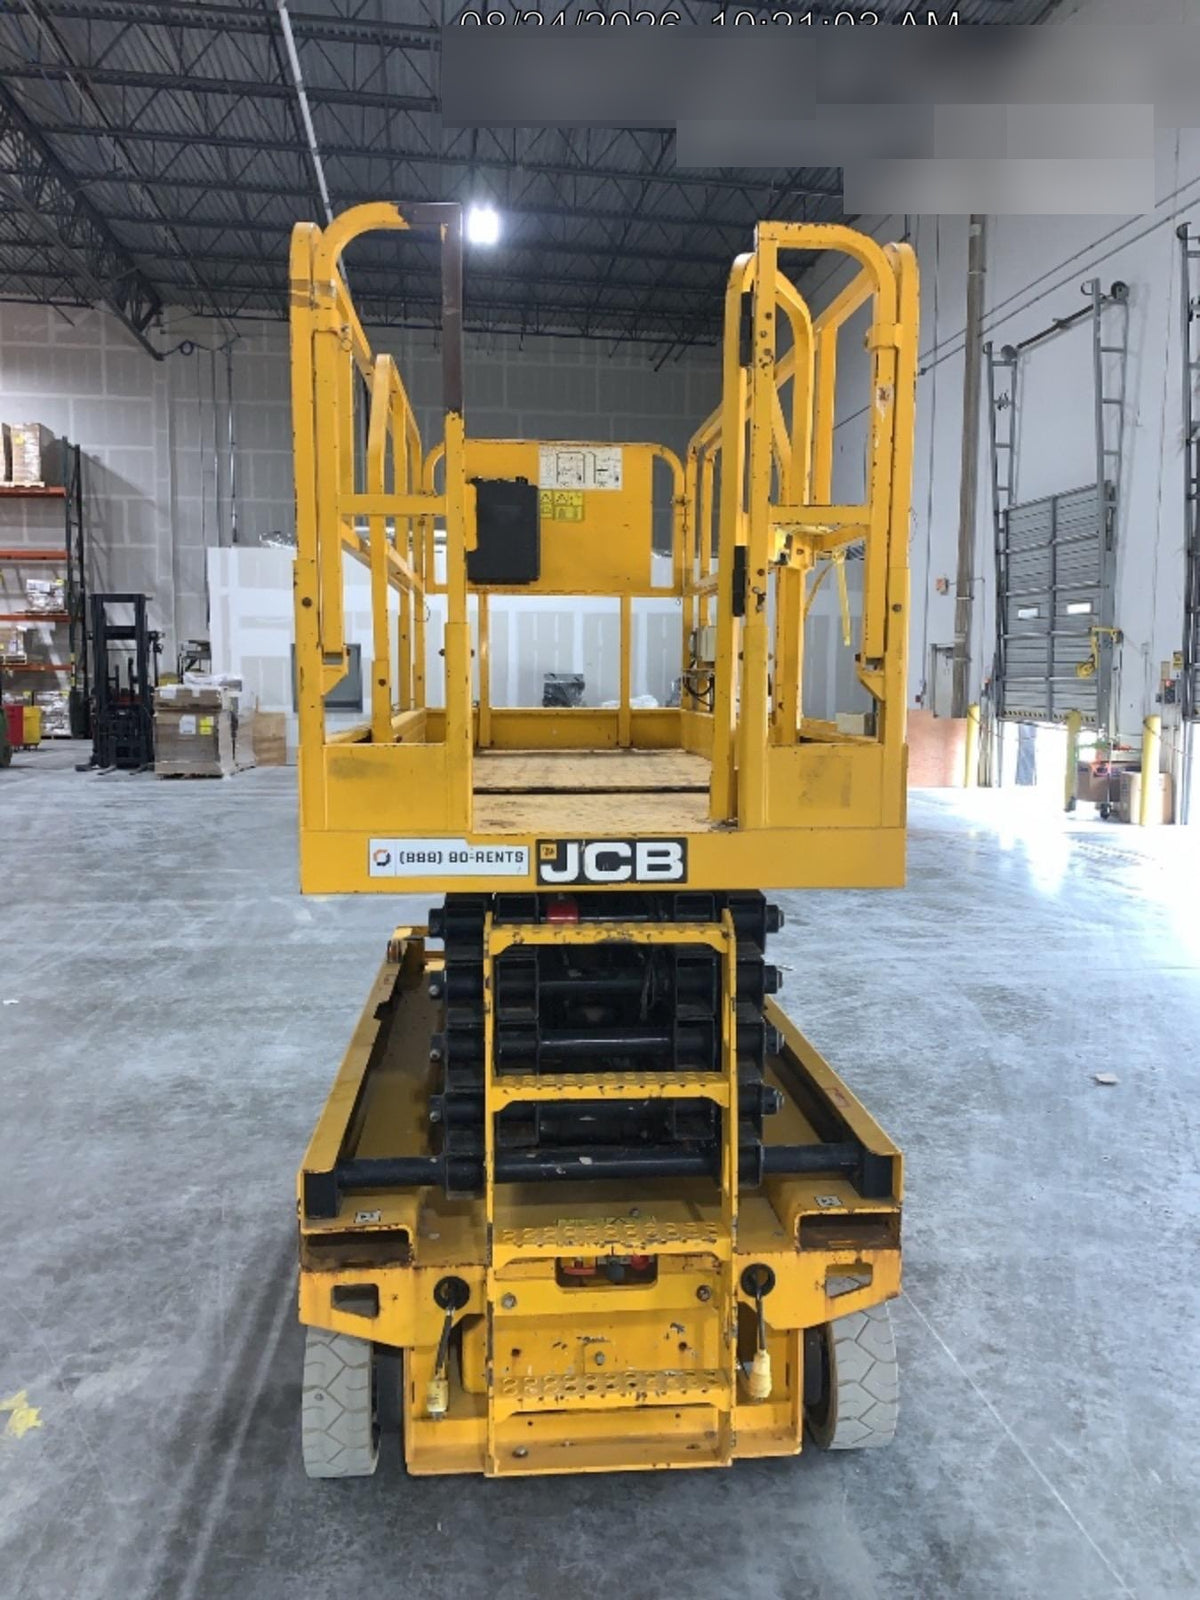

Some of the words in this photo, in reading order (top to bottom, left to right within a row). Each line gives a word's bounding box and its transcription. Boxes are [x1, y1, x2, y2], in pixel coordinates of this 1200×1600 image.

[399, 850, 443, 865] (888)
[448, 850, 525, 864] 80-RENTS
[540, 841, 684, 883] JCB
